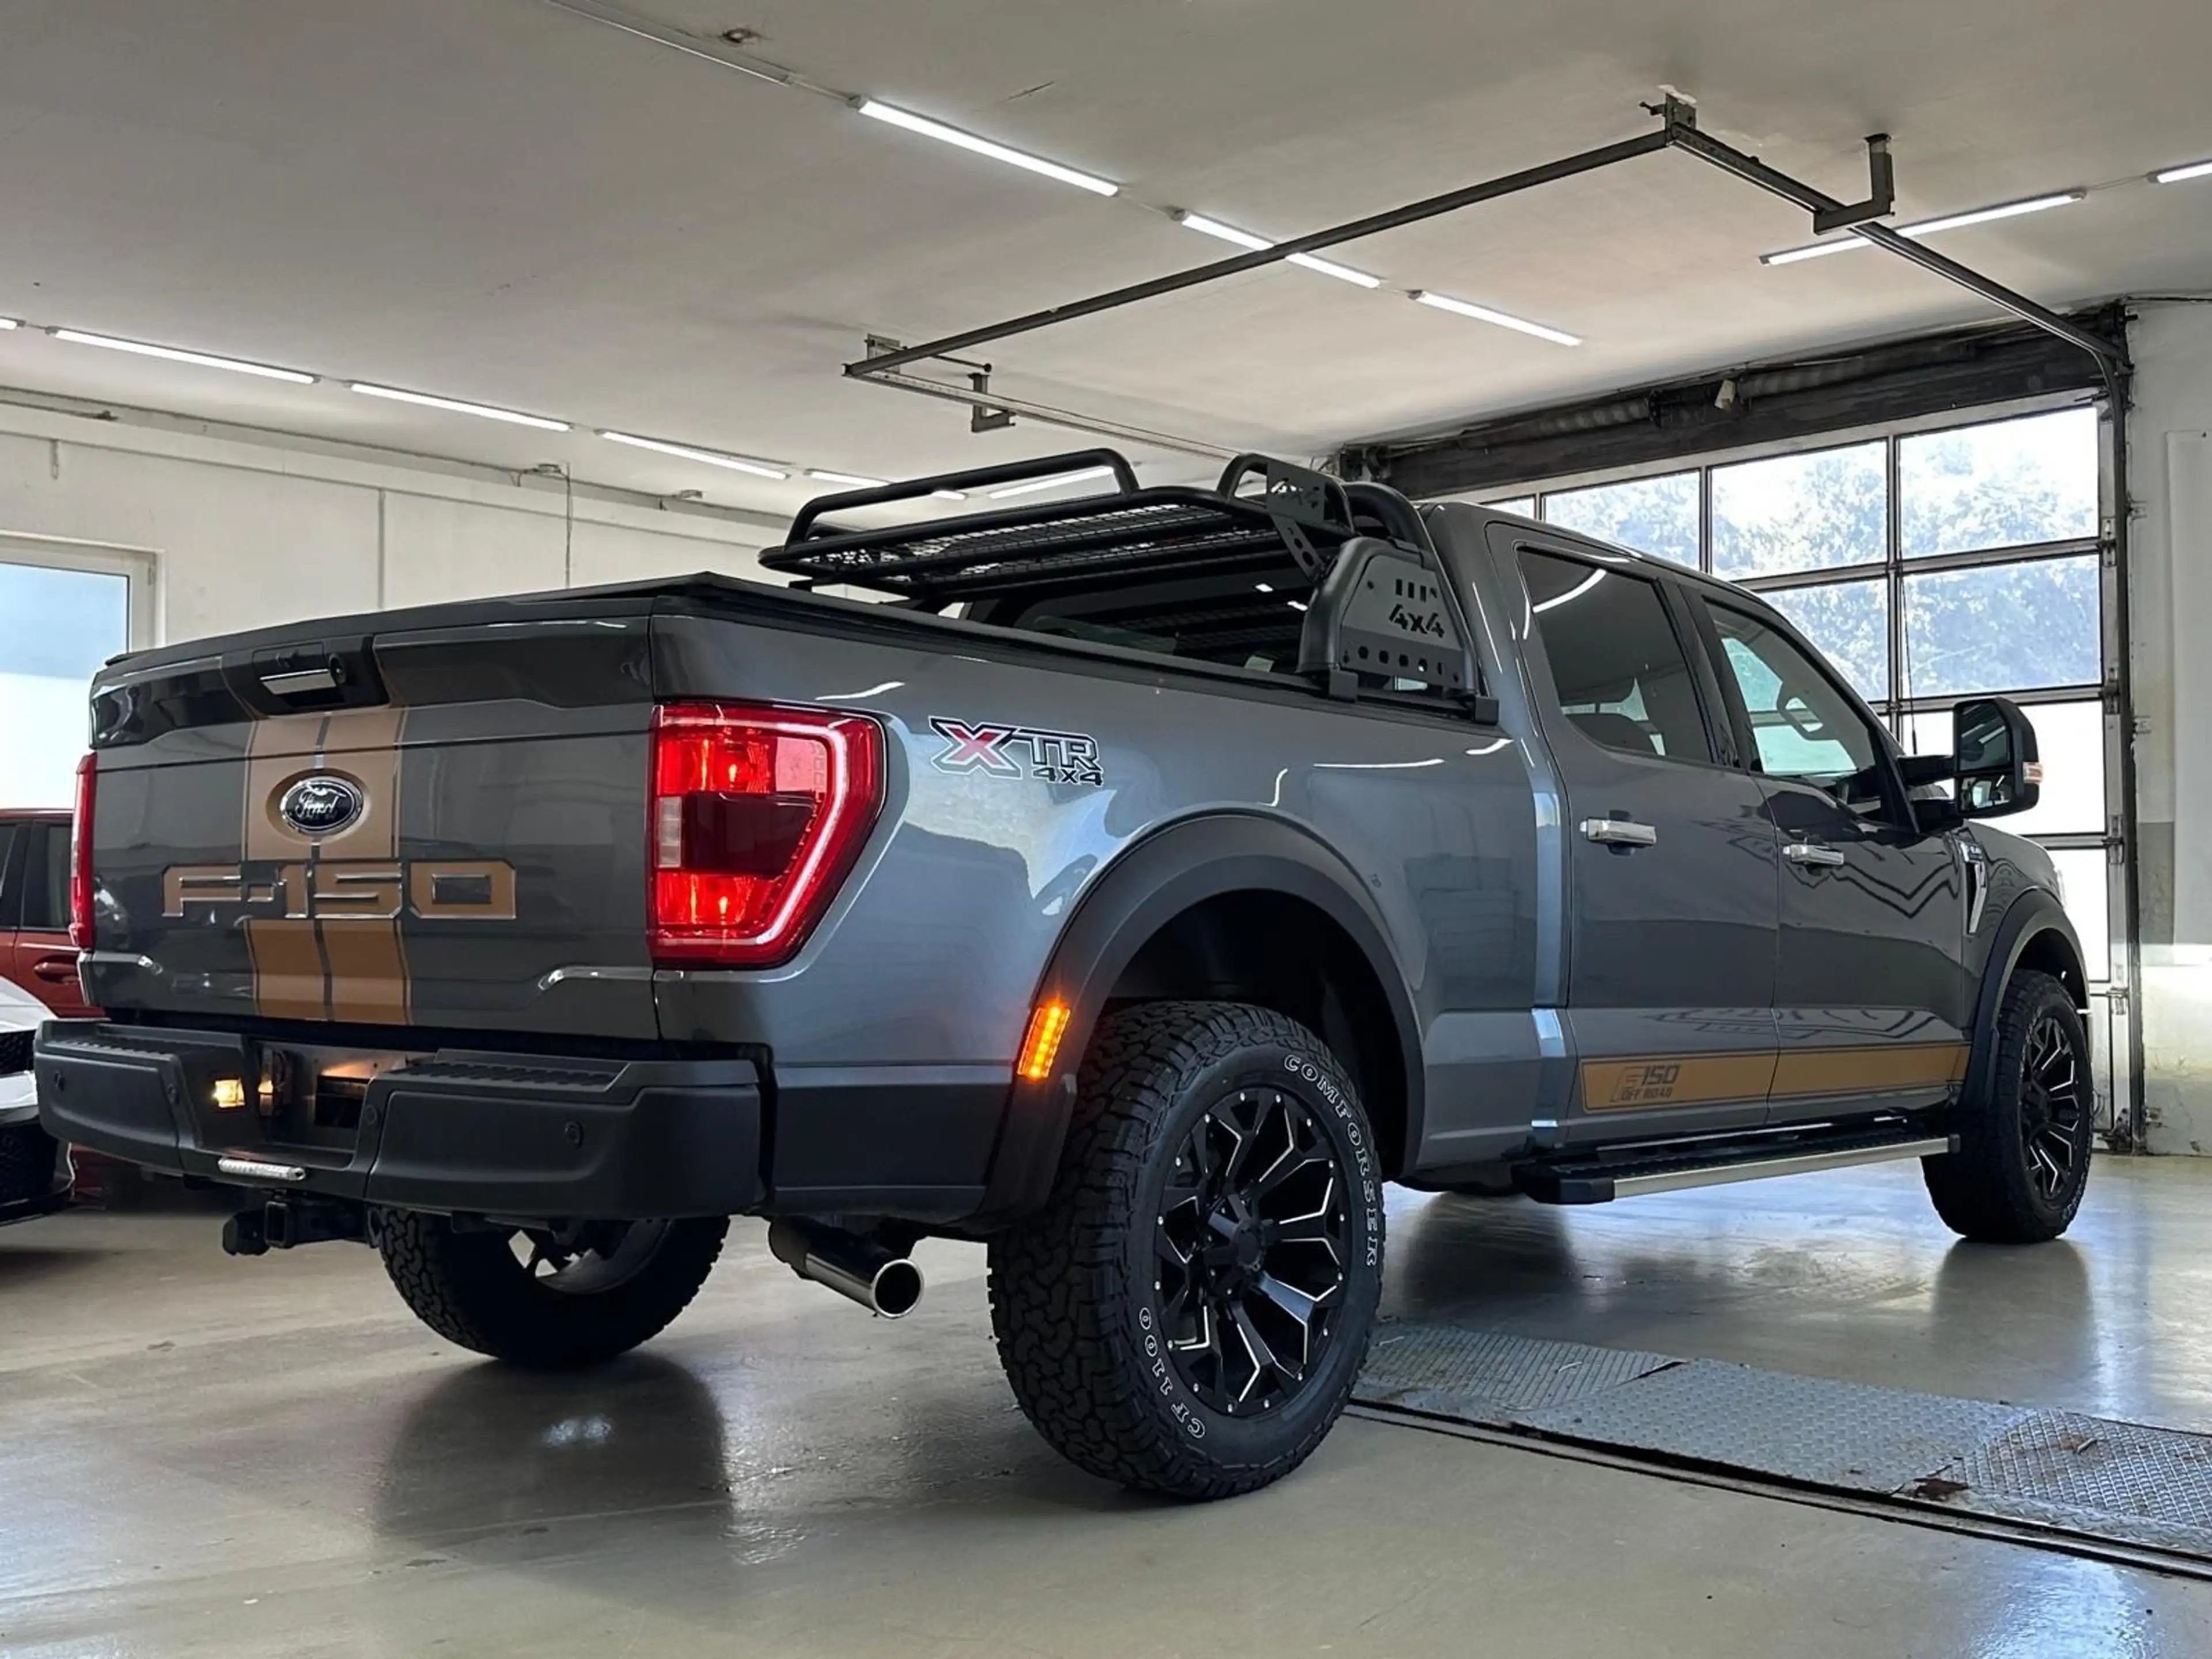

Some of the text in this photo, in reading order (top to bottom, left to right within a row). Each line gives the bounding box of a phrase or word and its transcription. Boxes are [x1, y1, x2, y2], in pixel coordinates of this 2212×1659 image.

[928, 715, 1103, 780] XTR
[1032, 766, 1104, 787] 4x4
[295, 782, 346, 819] Ford
[162, 859, 517, 920] F-150
[1284, 1054, 1378, 1267] COMFORSER
